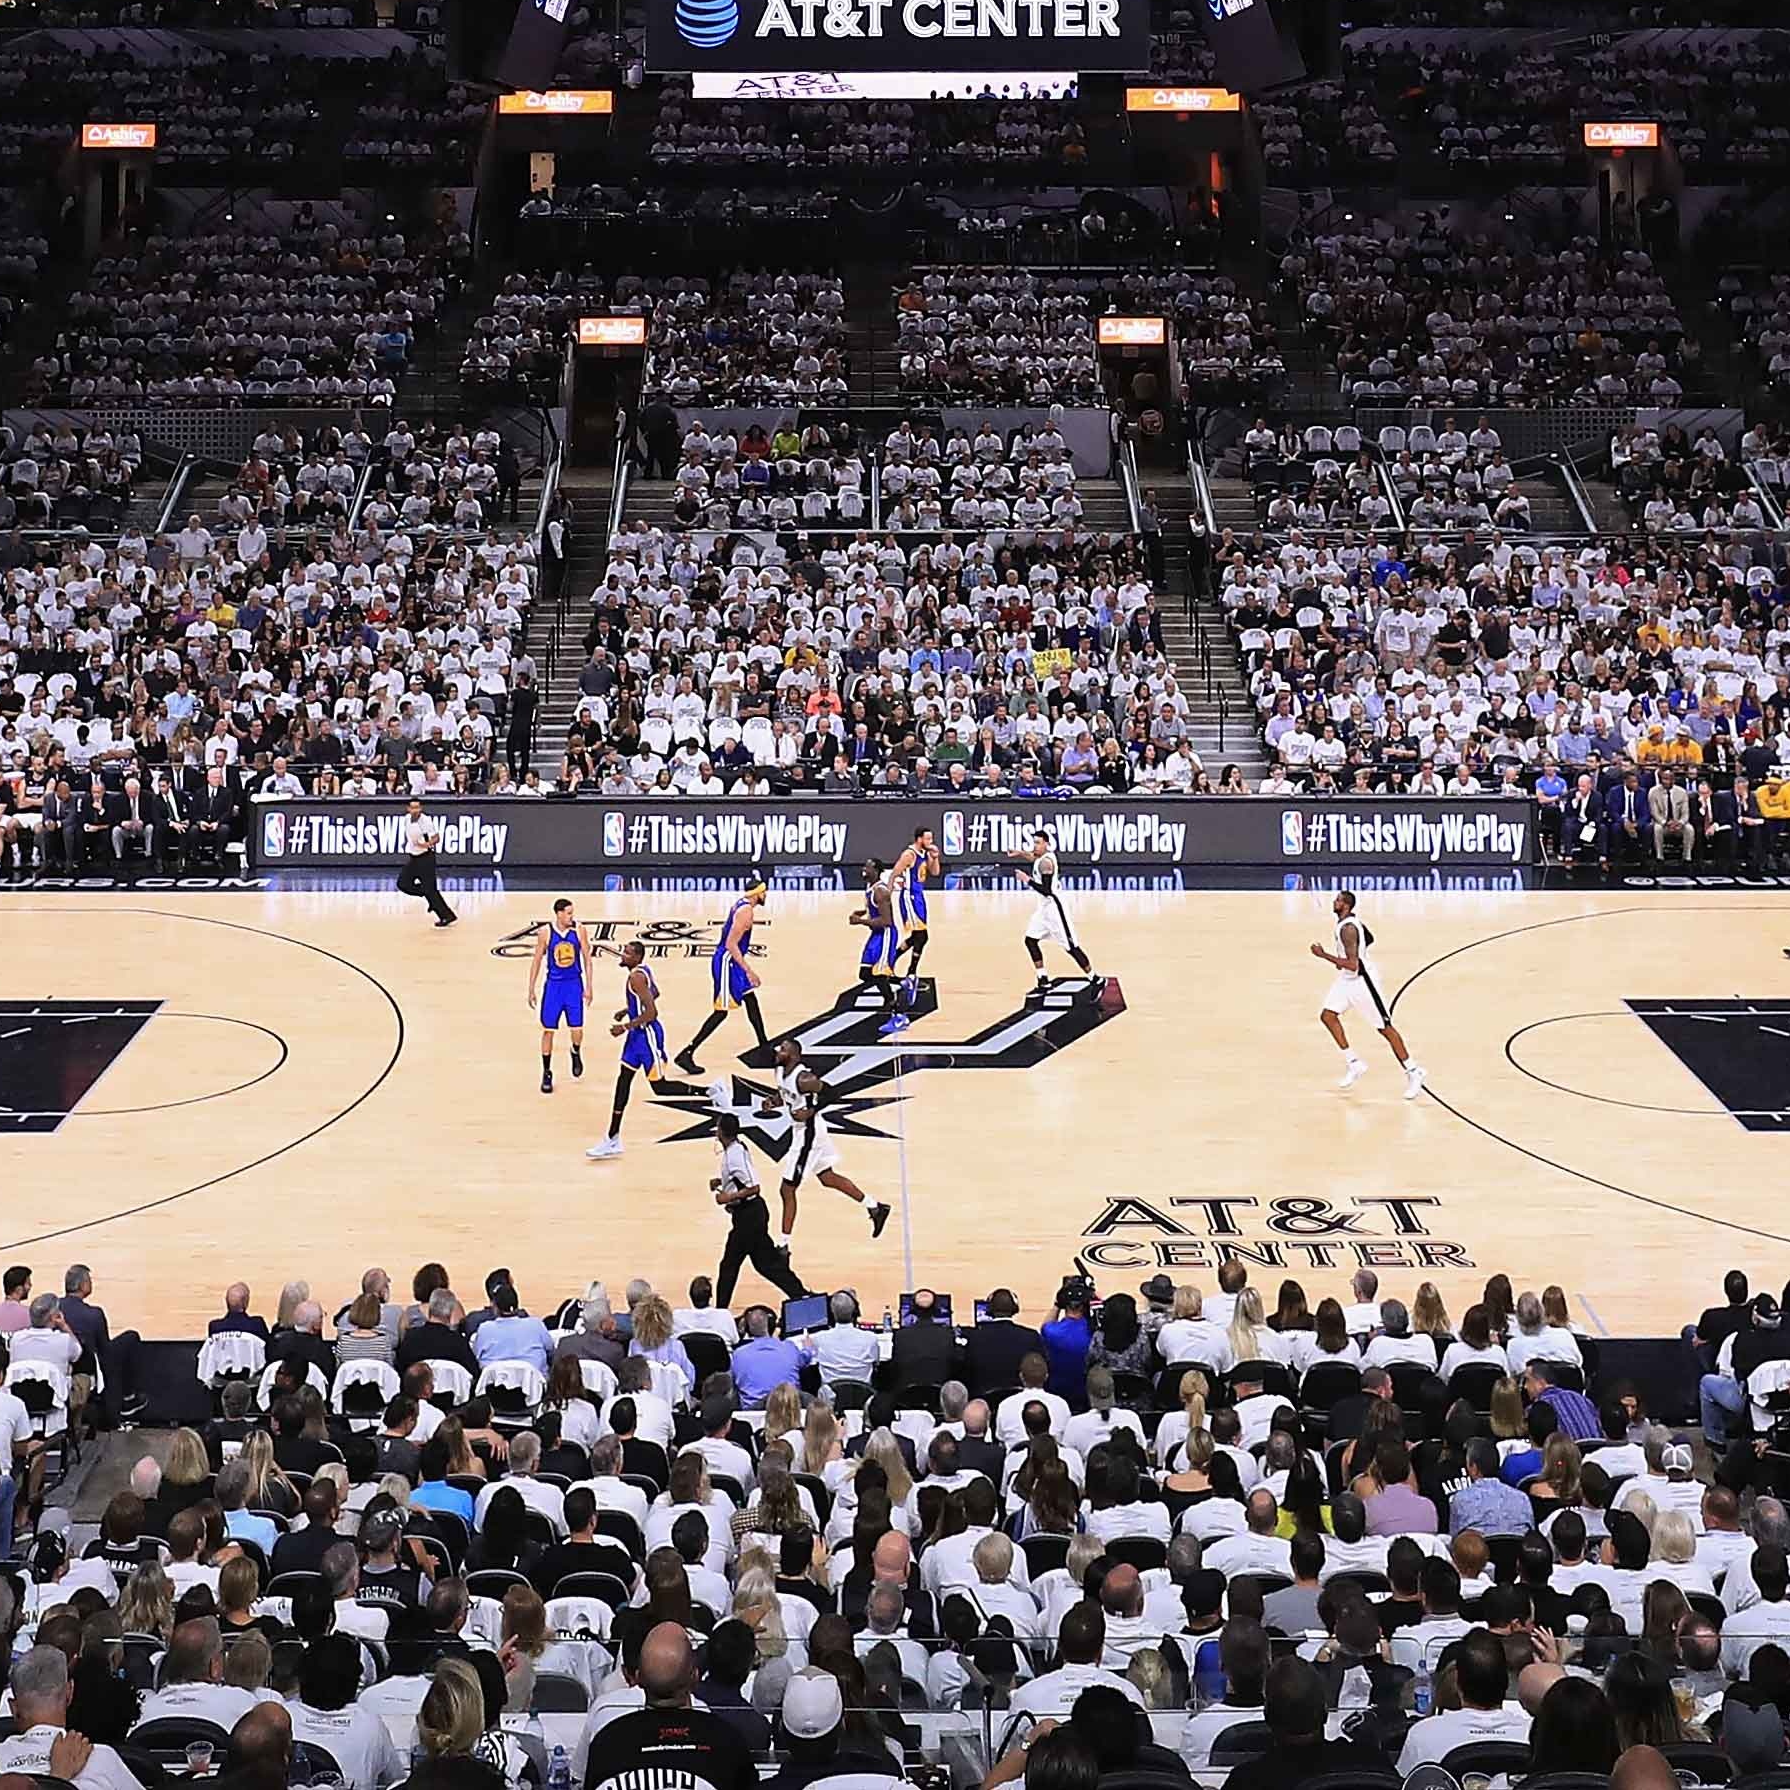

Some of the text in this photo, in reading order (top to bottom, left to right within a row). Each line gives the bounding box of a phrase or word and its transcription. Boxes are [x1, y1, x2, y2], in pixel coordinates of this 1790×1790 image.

[627, 813, 848, 863] #ThisIsWhyWePlay
[1306, 813, 1525, 862] #ThisIsWhyWePlay
[1081, 1195, 1442, 1236] AT&T
[1081, 1240, 1477, 1269] CENTER
